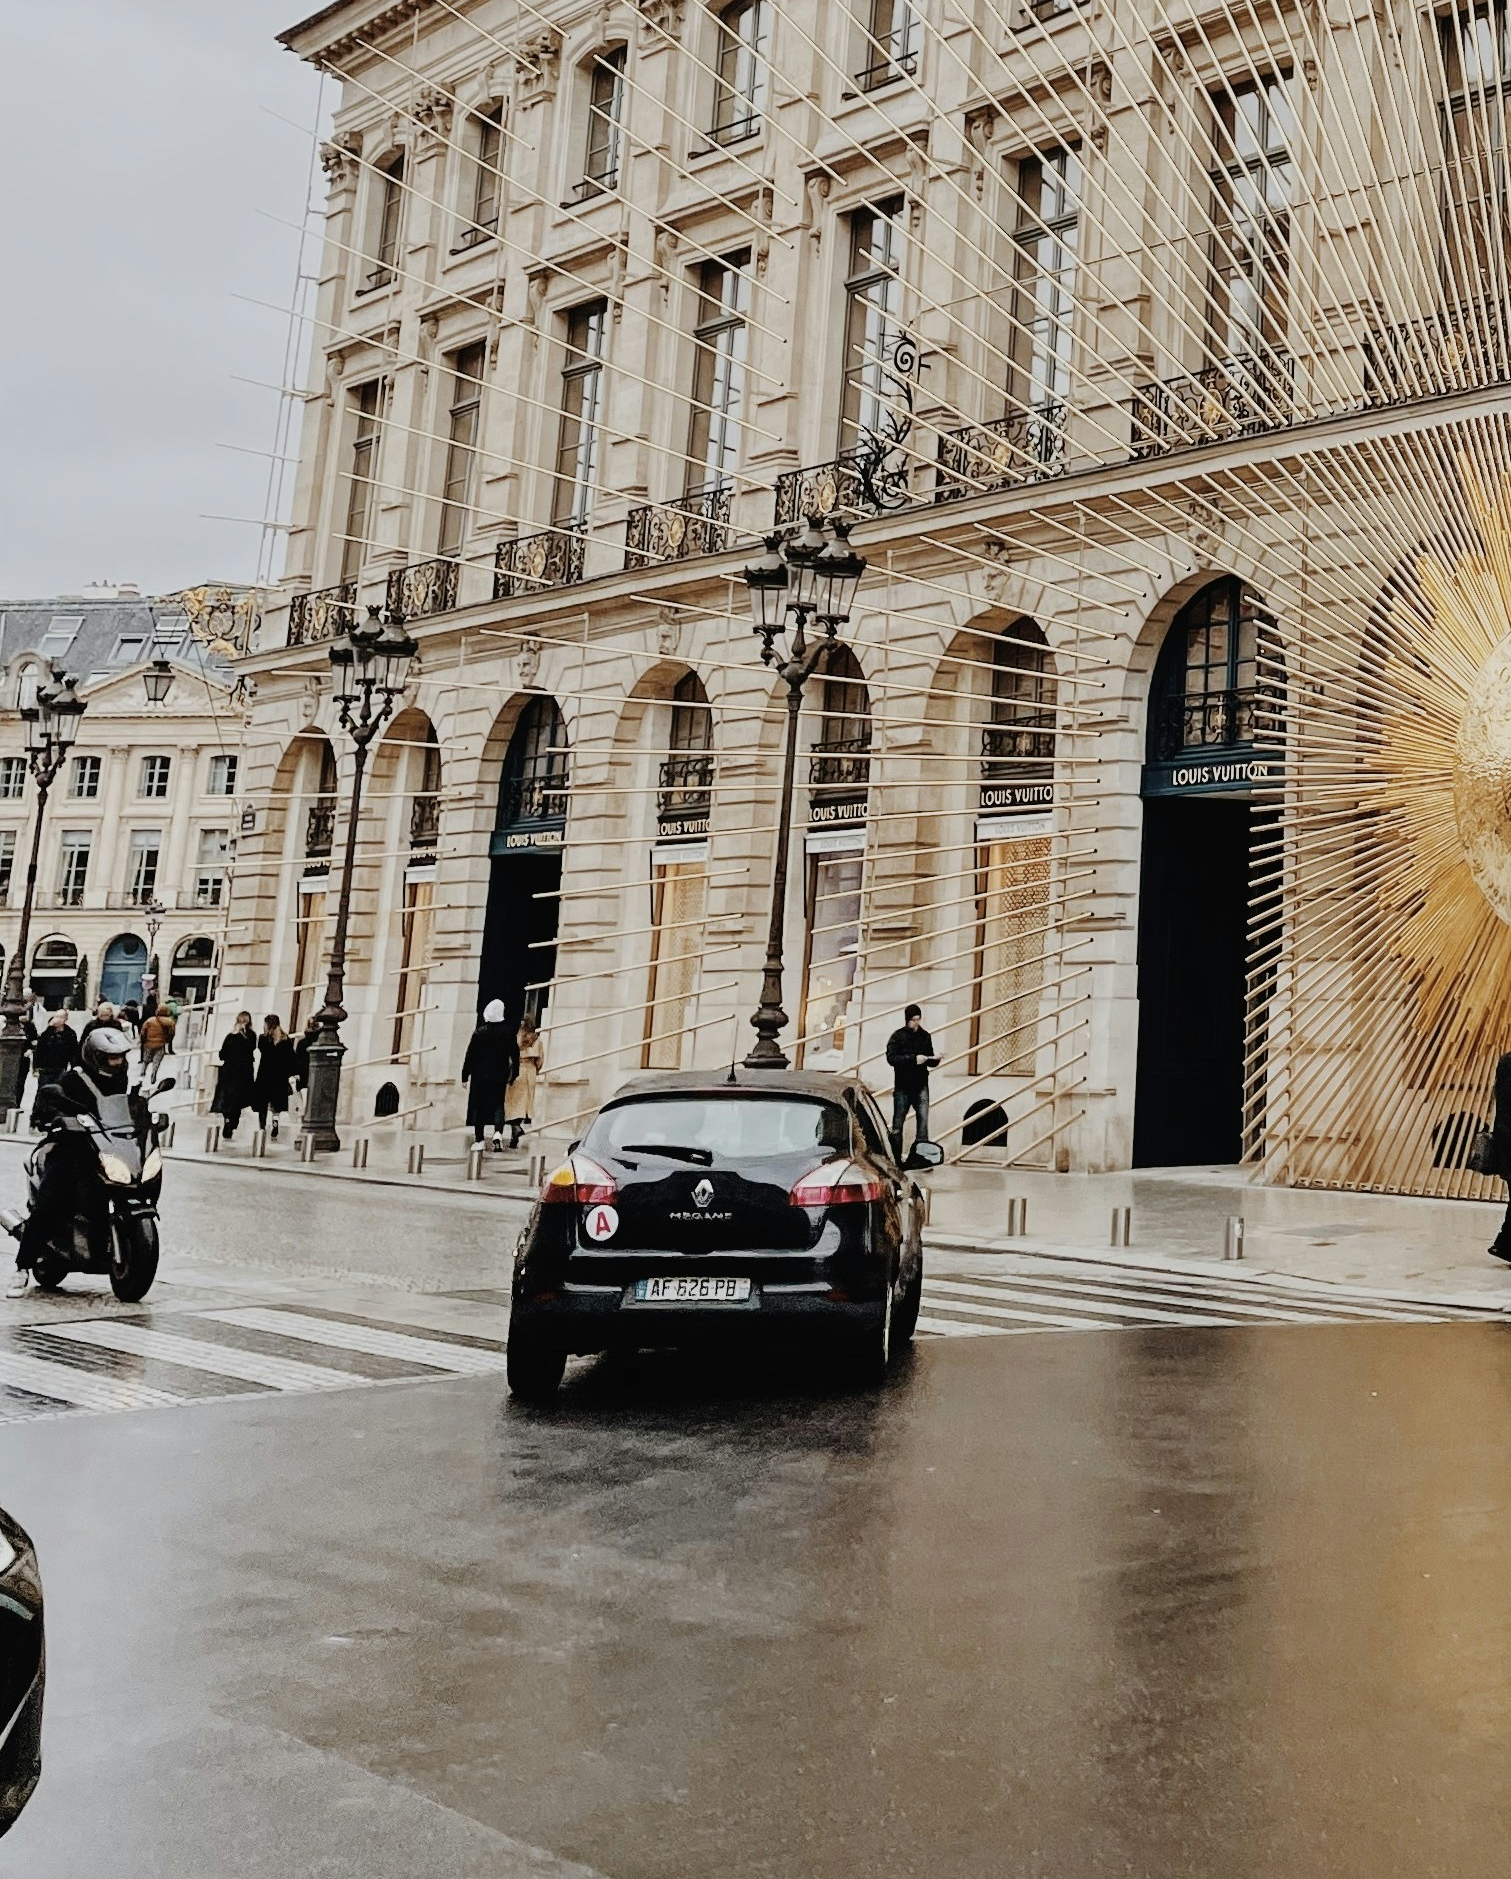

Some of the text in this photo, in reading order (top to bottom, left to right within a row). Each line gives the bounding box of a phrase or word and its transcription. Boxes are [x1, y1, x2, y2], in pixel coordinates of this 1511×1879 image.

[1172, 763, 1268, 786] LOUIS VUITTON
[981, 785, 1053, 806] LOUIS VUITTO
[809, 803, 868, 822] LOUIS VUITTO
[683, 818, 710, 833] VUITTO
[595, 1210, 612, 1237] A
